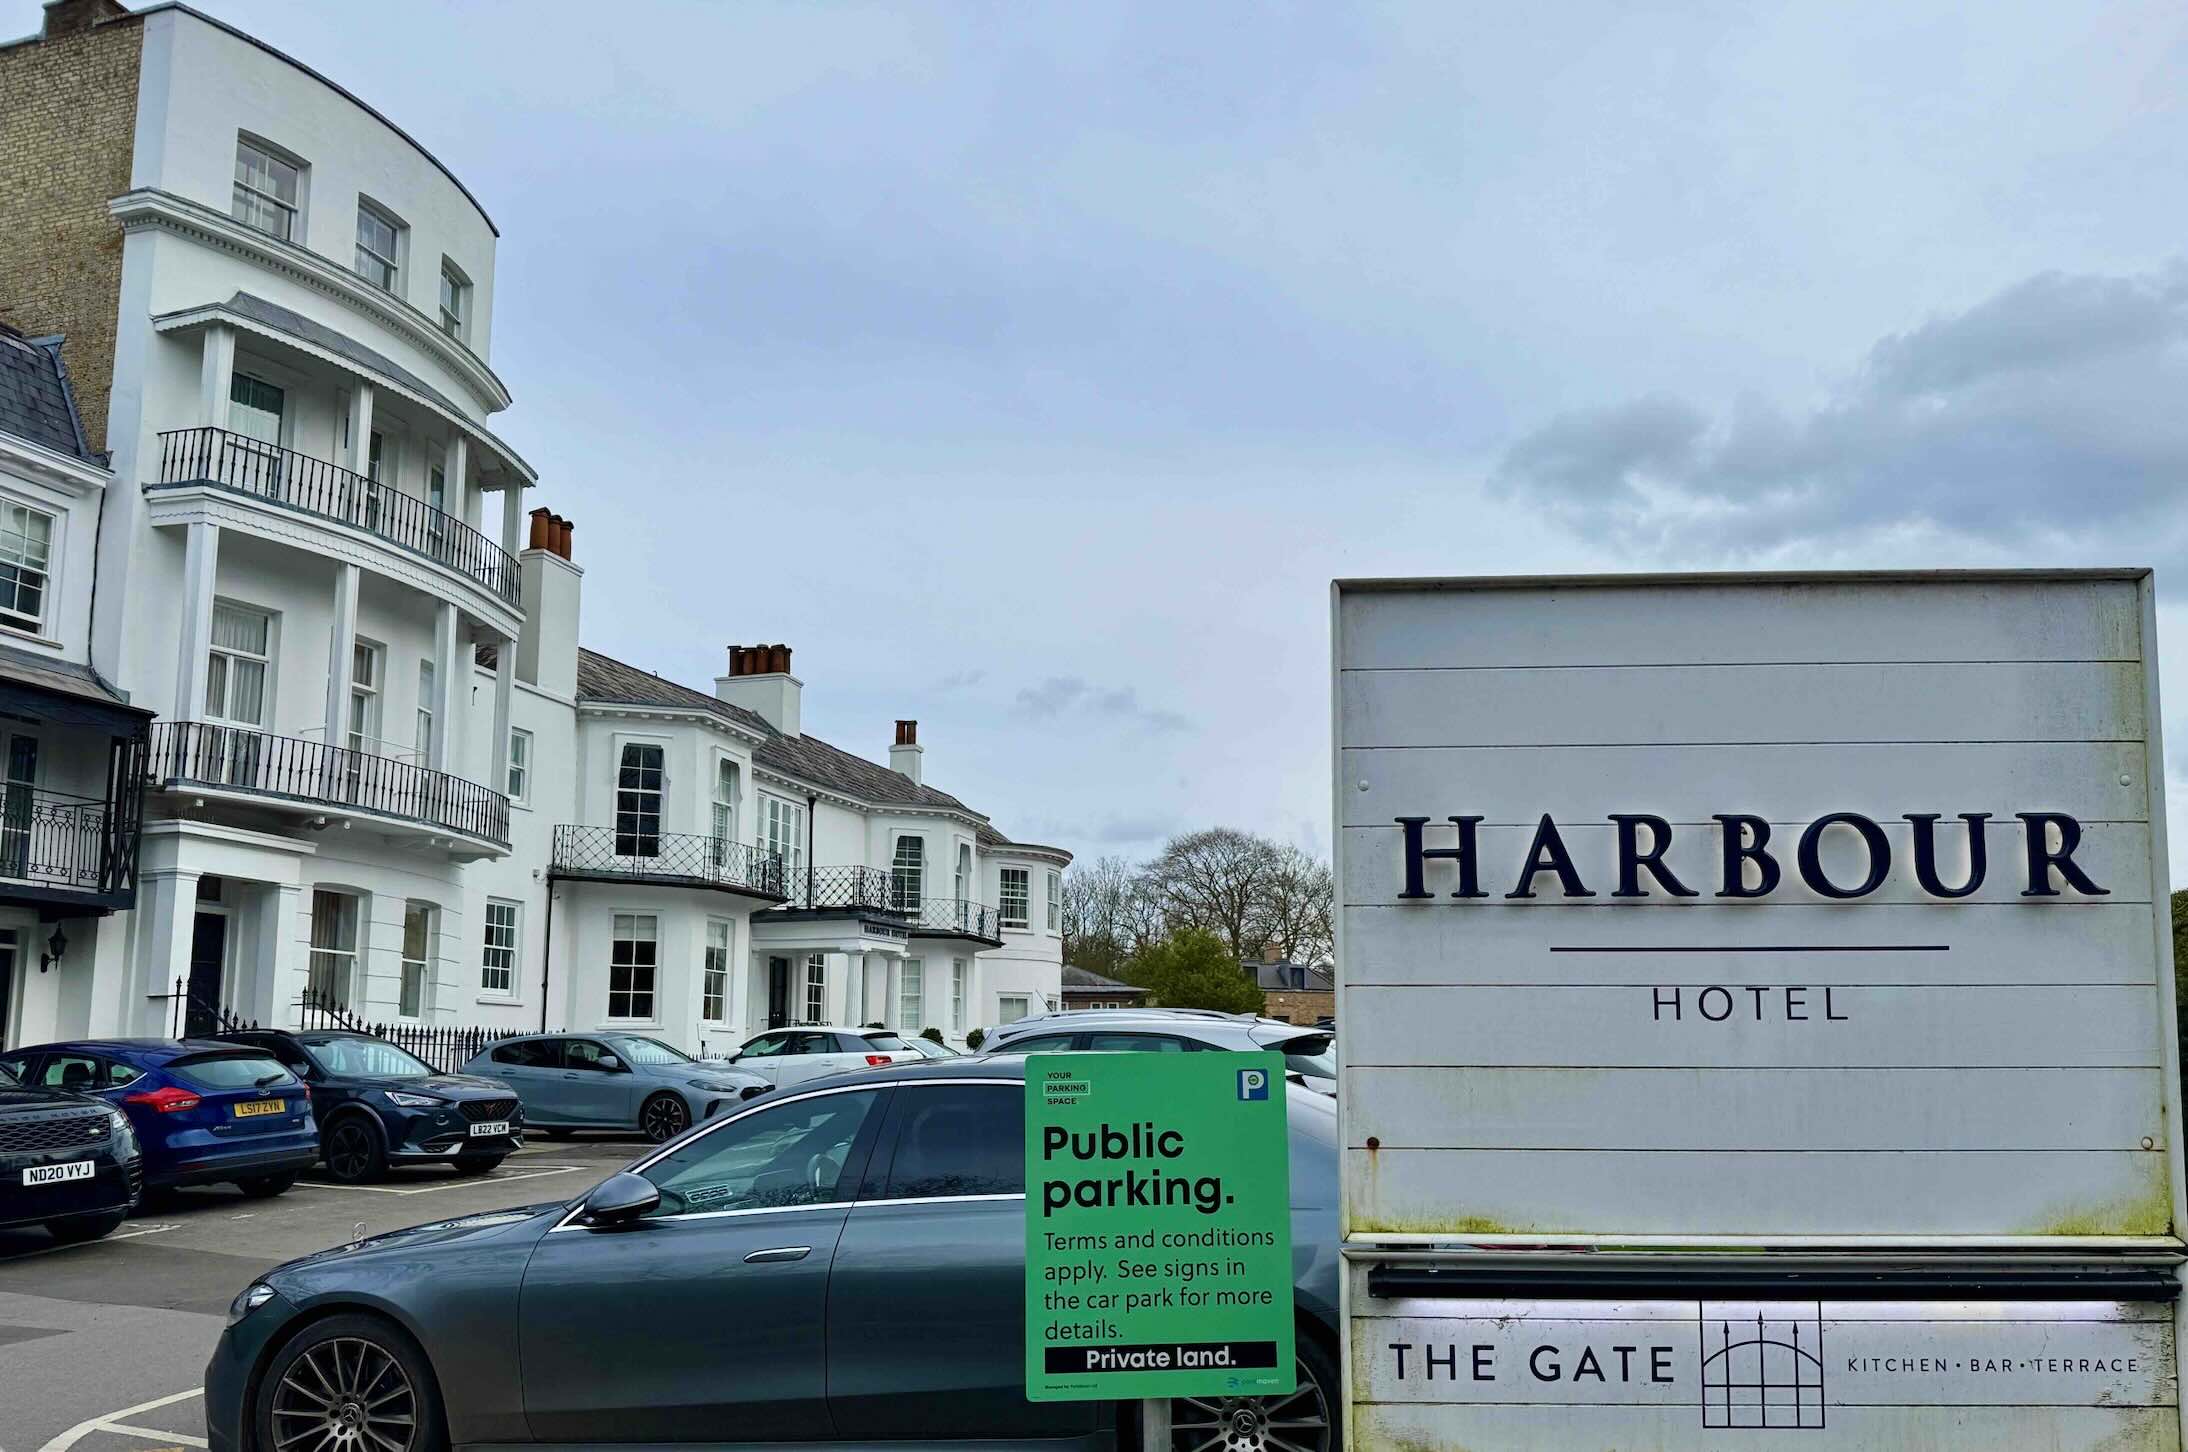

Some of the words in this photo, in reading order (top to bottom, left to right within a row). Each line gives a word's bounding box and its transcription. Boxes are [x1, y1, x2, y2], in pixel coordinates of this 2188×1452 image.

[1394, 812, 2111, 899] HARBOUR
[1652, 986, 1849, 1022] HOTEL
[1047, 1071, 1072, 1079] YOUR
[1047, 1084, 1087, 1092] PARKING
[241, 1103, 260, 1114] LS17
[263, 1100, 281, 1112] ZYN
[1047, 1097, 1077, 1105] SPACE
[1044, 1122, 1184, 1161] Public
[29, 1166, 64, 1183] ND20
[67, 1163, 90, 1178] VYJ
[1044, 1168, 1234, 1218] parking.
[1044, 1232, 1107, 1250] Terms
[1115, 1229, 1155, 1248] and
[1162, 1228, 1274, 1247] conditions
[1045, 1259, 1107, 1285] apply.
[1117, 1260, 1158, 1278] See
[1164, 1258, 1219, 1281] signs
[1226, 1257, 1246, 1276] in
[1044, 1290, 1080, 1310] the
[1087, 1290, 1119, 1308] car
[1126, 1288, 1174, 1313] park
[1180, 1286, 1210, 1306] for
[1216, 1289, 1273, 1305] more
[1045, 1319, 1123, 1340] details.
[1086, 1348, 1171, 1369] Private
[1176, 1345, 1237, 1367] land.
[1389, 1344, 1495, 1381] THE
[1529, 1345, 1674, 1382] GATE
[1848, 1358, 1947, 1372] KITCHEN
[1970, 1359, 2012, 1372] BAR
[2033, 1359, 2137, 1372] TERRACE
